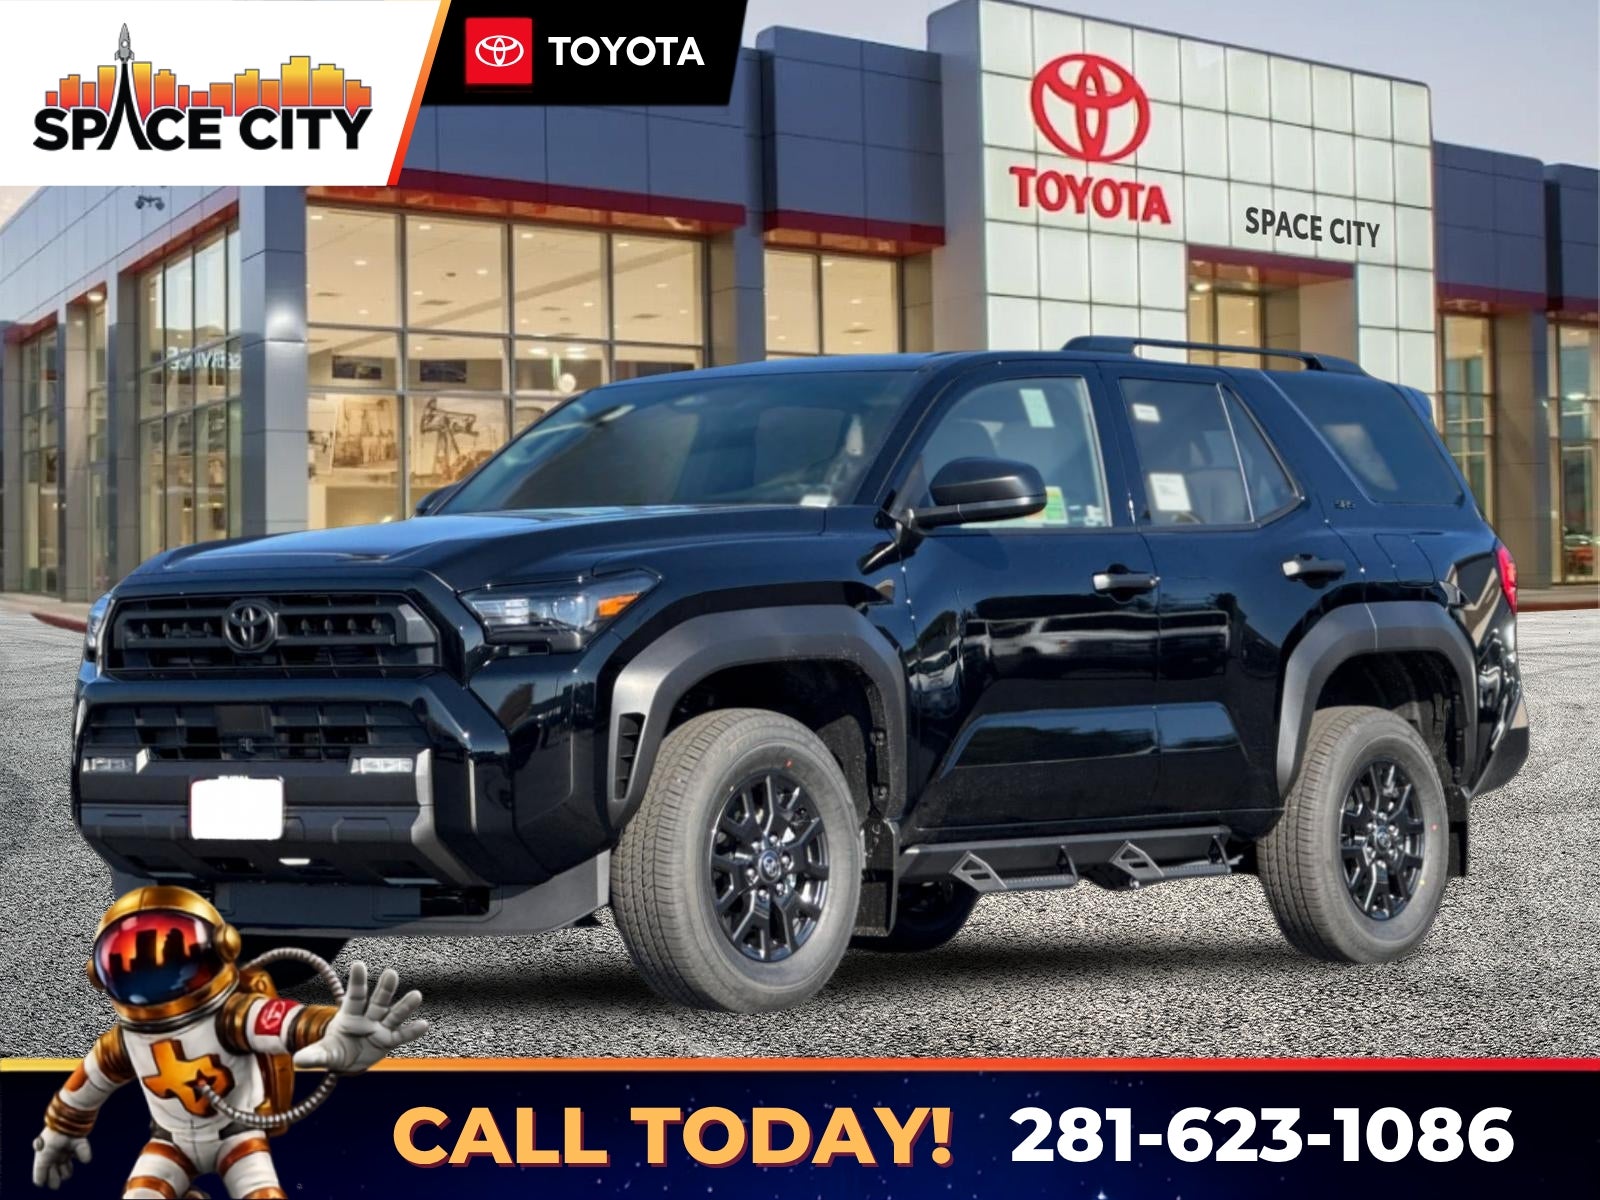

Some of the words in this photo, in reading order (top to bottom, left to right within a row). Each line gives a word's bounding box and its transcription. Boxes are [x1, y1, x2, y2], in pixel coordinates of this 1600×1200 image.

[1009, 167, 1171, 224] TOYOTA
[1244, 206, 1323, 242] SPACE
[1329, 218, 1381, 248] CITY
